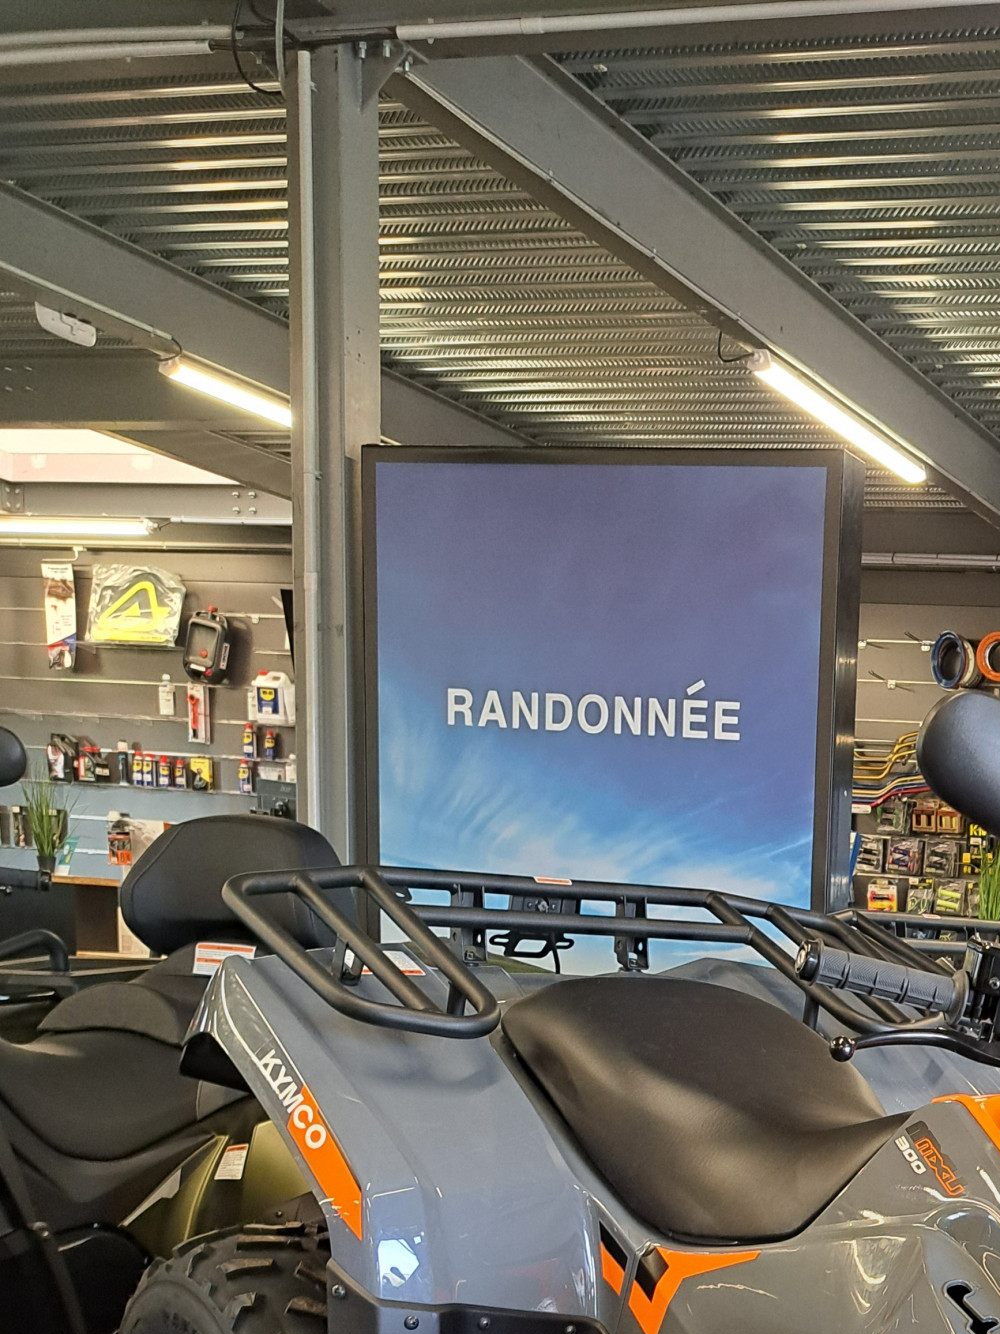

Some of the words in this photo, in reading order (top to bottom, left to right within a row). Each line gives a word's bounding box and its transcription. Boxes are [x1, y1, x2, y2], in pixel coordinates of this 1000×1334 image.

[447, 679, 741, 741] RANDONNÉE
[259, 1048, 327, 1150] KYMCO
[894, 1135, 927, 1175] 300
